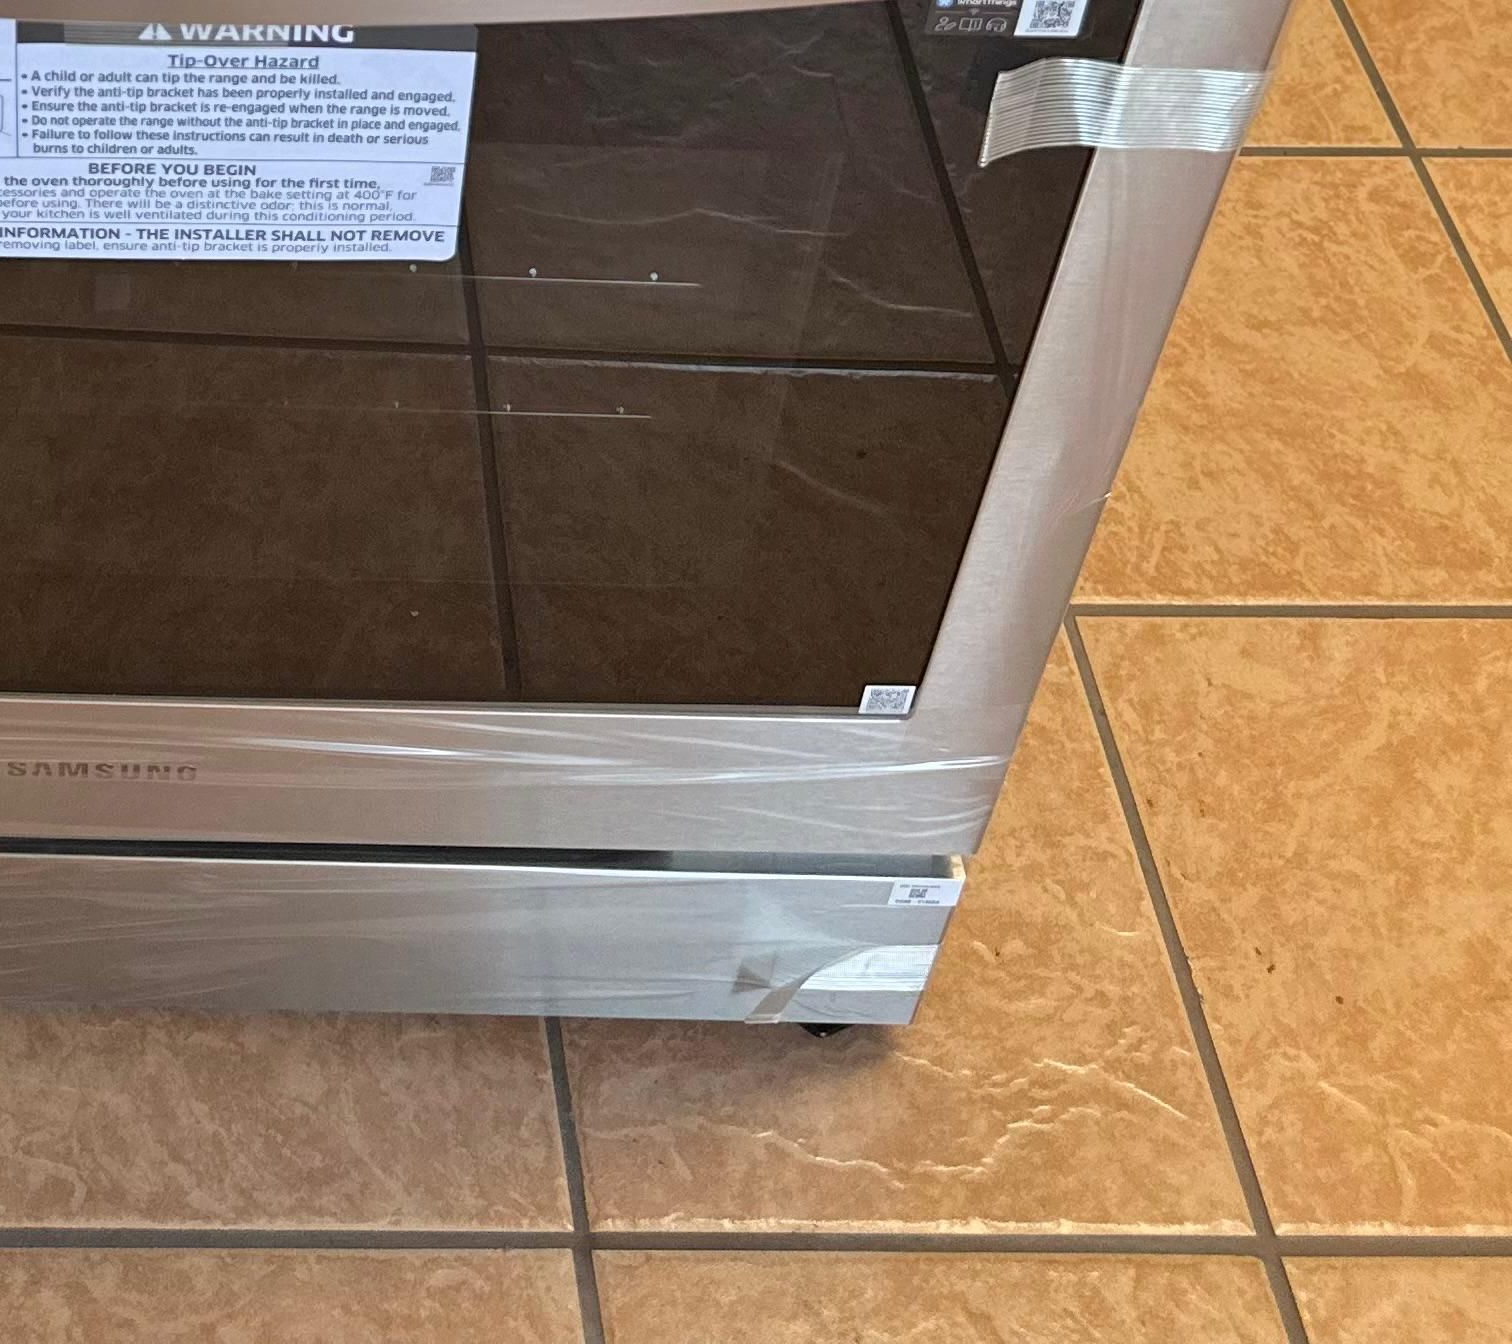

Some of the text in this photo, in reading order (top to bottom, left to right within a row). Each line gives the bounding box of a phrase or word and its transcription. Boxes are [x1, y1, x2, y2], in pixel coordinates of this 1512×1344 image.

[180, 23, 354, 42] WARNING
[167, 53, 320, 69] Tip-Over Hazard
[30, 69, 340, 85] A child or adult can tip the range and be killed.
[31, 85, 455, 104] Verify the anti-tip bracket has been properly installed and engaged.
[31, 100, 450, 117] Ensure the anti-tip bracket is re-engaged when the range is moved.
[88, 162, 256, 176] BEFORE YOU BEGIN
[3, 175, 28, 186] the
[31, 177, 69, 186] oven
[71, 175, 155, 188] thoroughly
[158, 176, 208, 188] before
[210, 177, 253, 189] using
[254, 176, 277, 188] for
[280, 177, 305, 188] the
[308, 177, 340, 190] first
[343, 177, 380, 192] time,
[135, 228, 169, 240] THE
[174, 228, 267, 240] INSTALLER
[270, 229, 326, 241] SHALL
[330, 229, 367, 241] NOT
[370, 229, 445, 242] REMOVE
[6, 761, 198, 781] SAMSUNG
